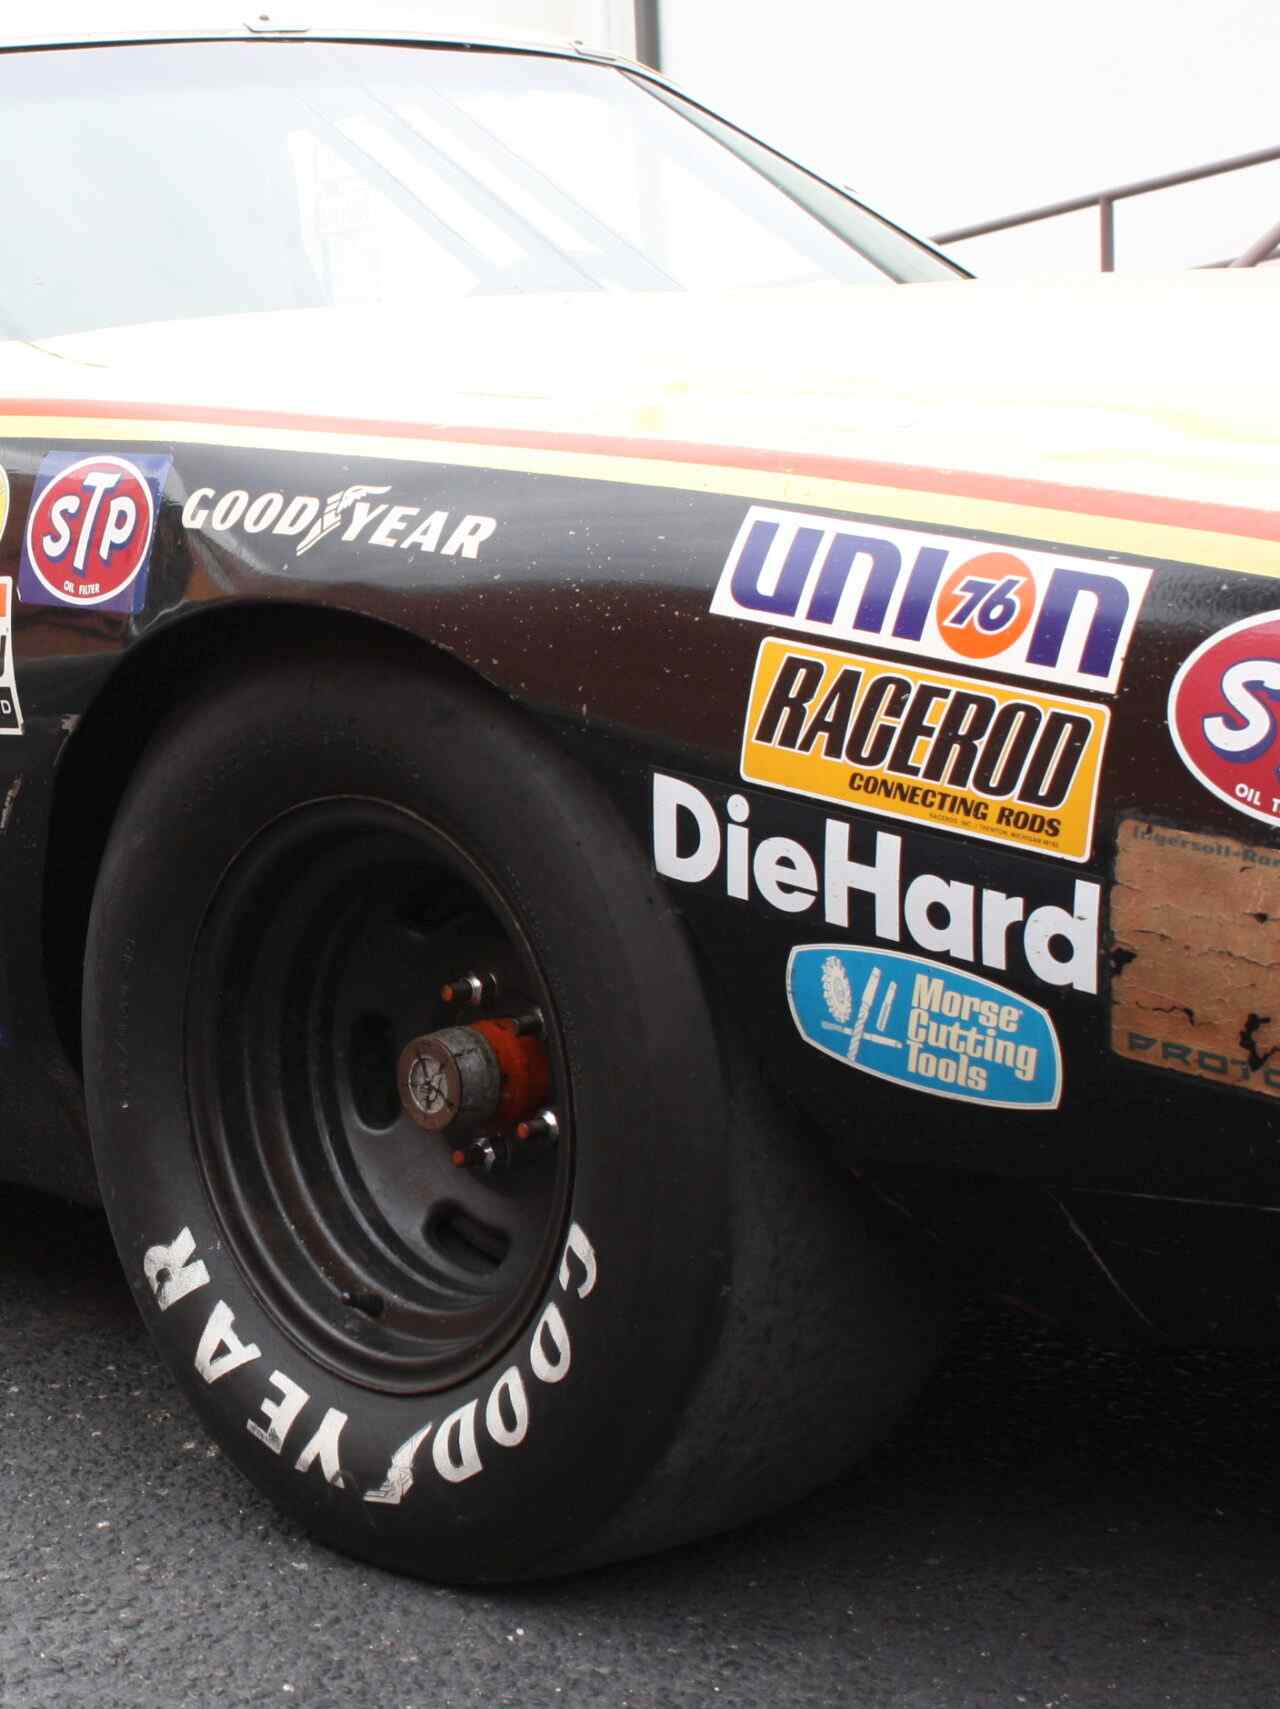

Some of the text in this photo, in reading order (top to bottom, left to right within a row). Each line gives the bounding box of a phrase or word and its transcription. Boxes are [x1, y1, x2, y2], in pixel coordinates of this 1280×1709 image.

[42, 471, 137, 571] STP
[63, 580, 101, 595] OIL FILTER
[943, 573, 1026, 635] 76
[752, 653, 1094, 810] RACEROD
[848, 772, 1062, 837] CONNECTING RODS
[1235, 783, 1261, 806] OIL
[653, 772, 1101, 995] DieHard
[911, 973, 1020, 1033] Morse
[906, 1039, 989, 1092] Tools
[907, 1008, 1038, 1081] Cutting
